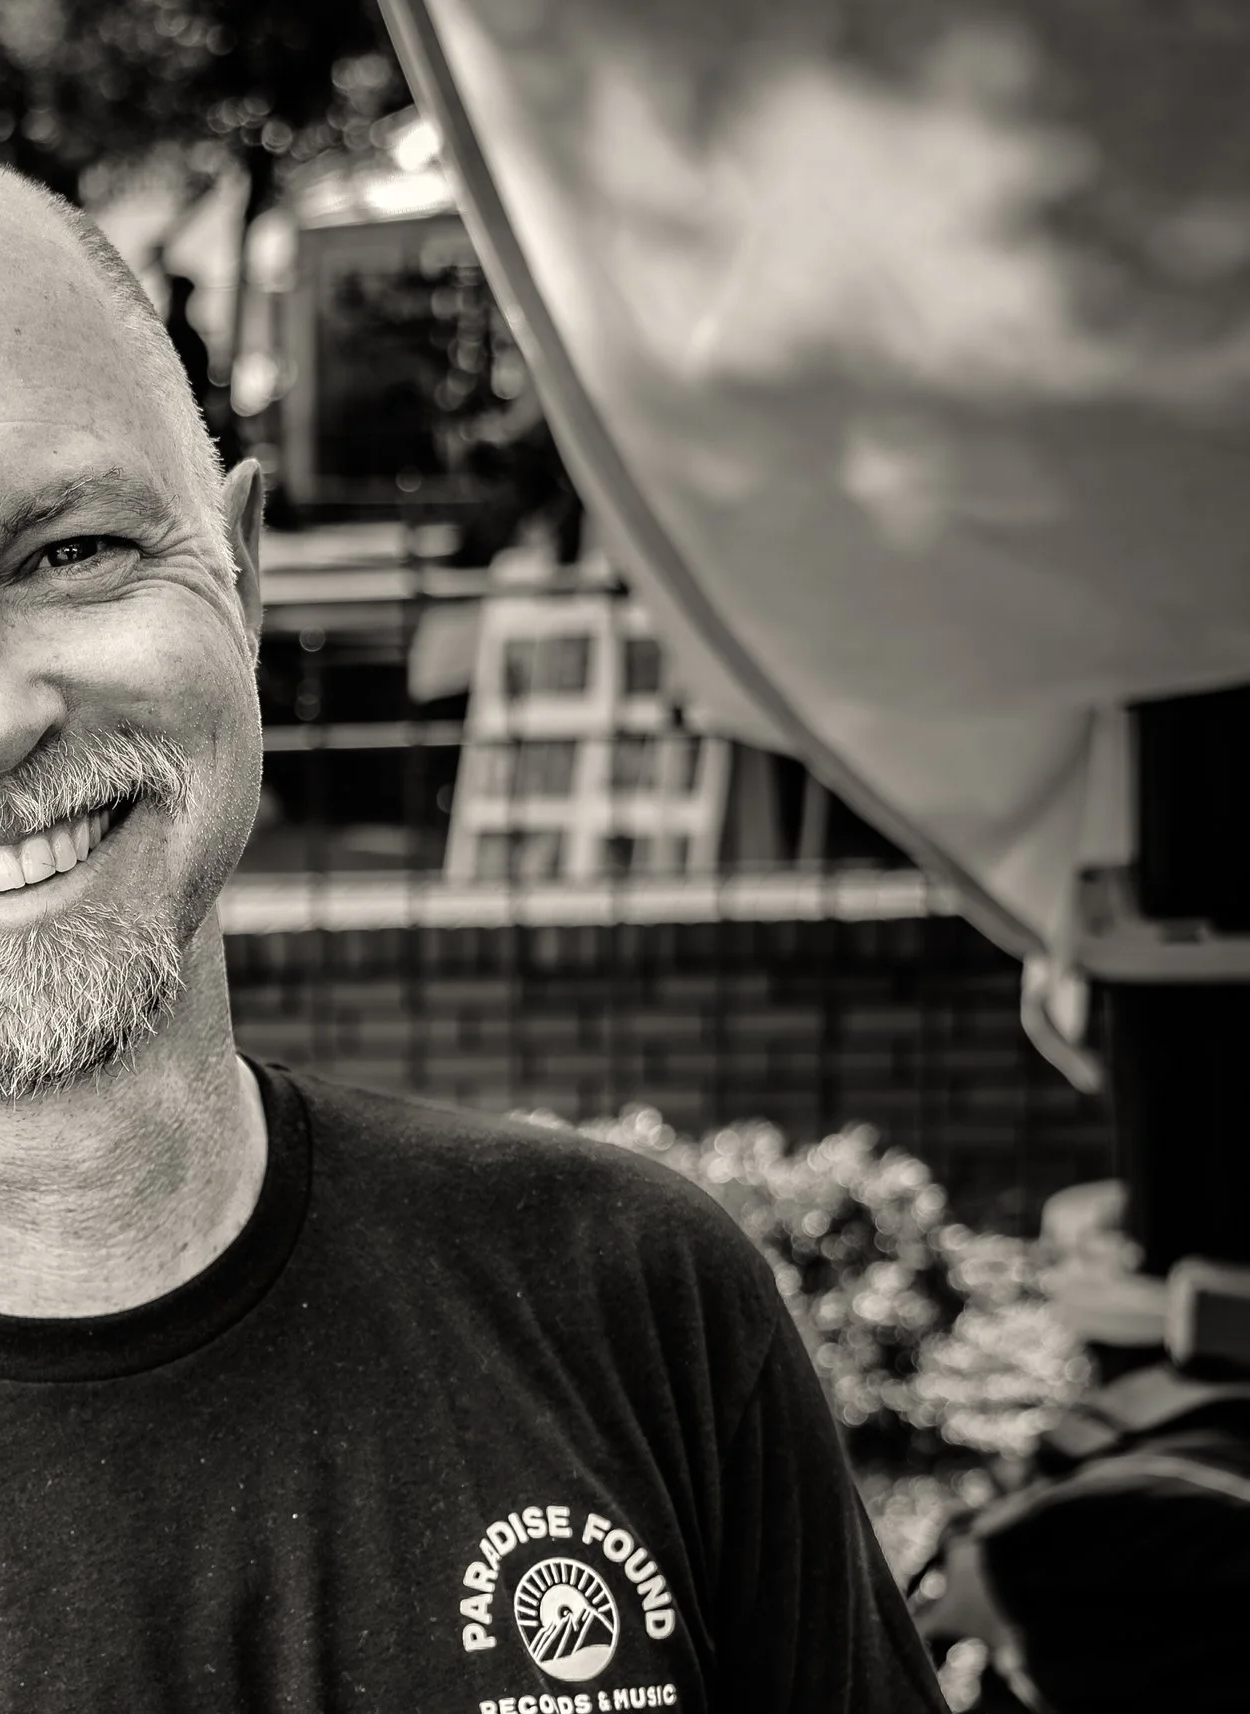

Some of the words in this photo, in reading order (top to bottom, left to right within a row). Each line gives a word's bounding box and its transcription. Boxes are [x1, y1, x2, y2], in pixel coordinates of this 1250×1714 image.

[459, 1505, 573, 1653] PARADISE
[581, 1512, 675, 1640] FOUND
[597, 1690, 613, 1712] &
[613, 1683, 677, 1711] MUSIC
